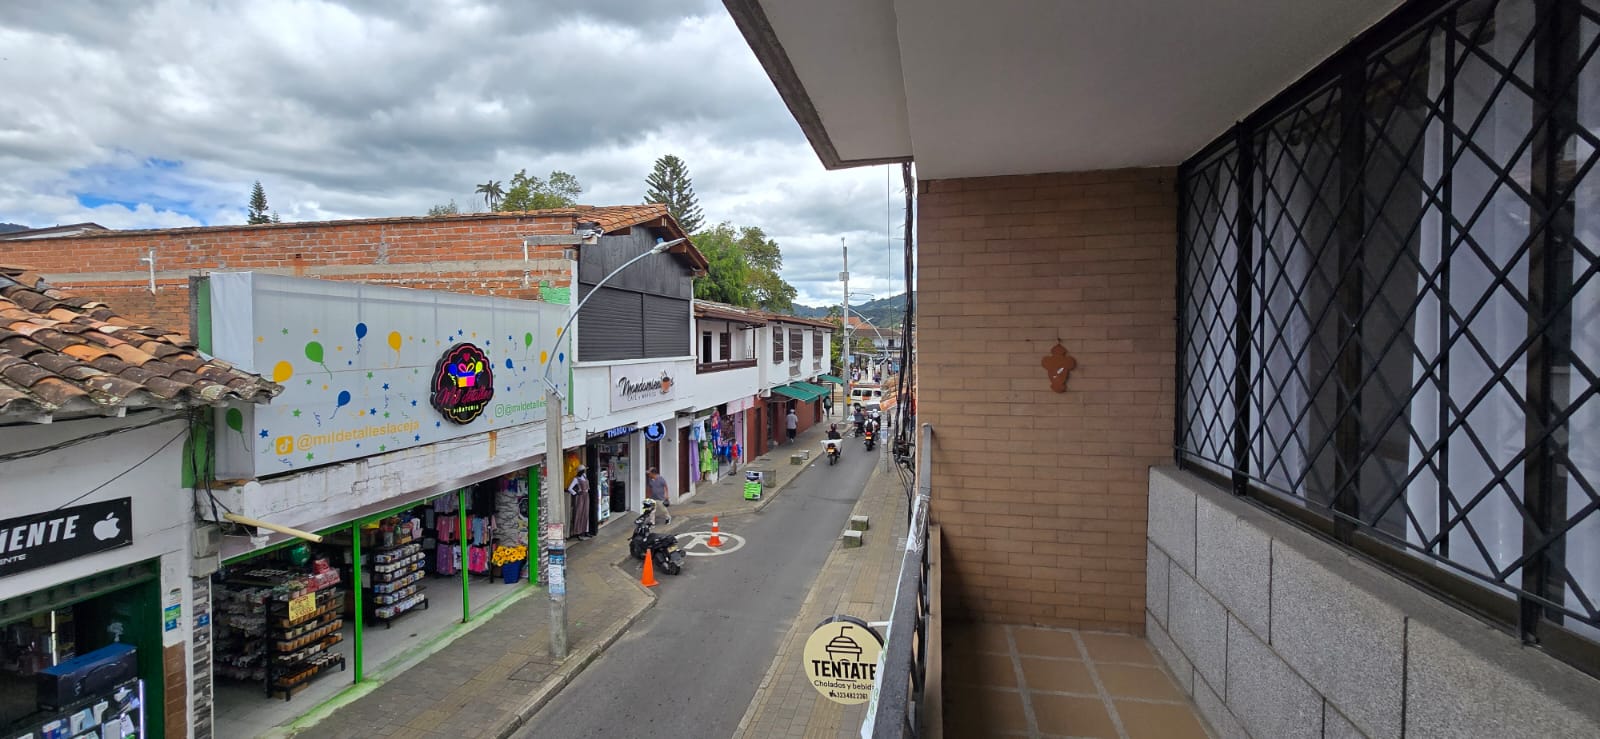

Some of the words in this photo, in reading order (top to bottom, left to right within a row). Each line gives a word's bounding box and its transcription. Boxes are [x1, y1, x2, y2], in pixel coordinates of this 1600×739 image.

[618, 376, 674, 396] Mandamiens
[297, 420, 420, 451] @mildetalleslaceja
[812, 660, 877, 680] TENTATE
[814, 680, 846, 689] Cholados
